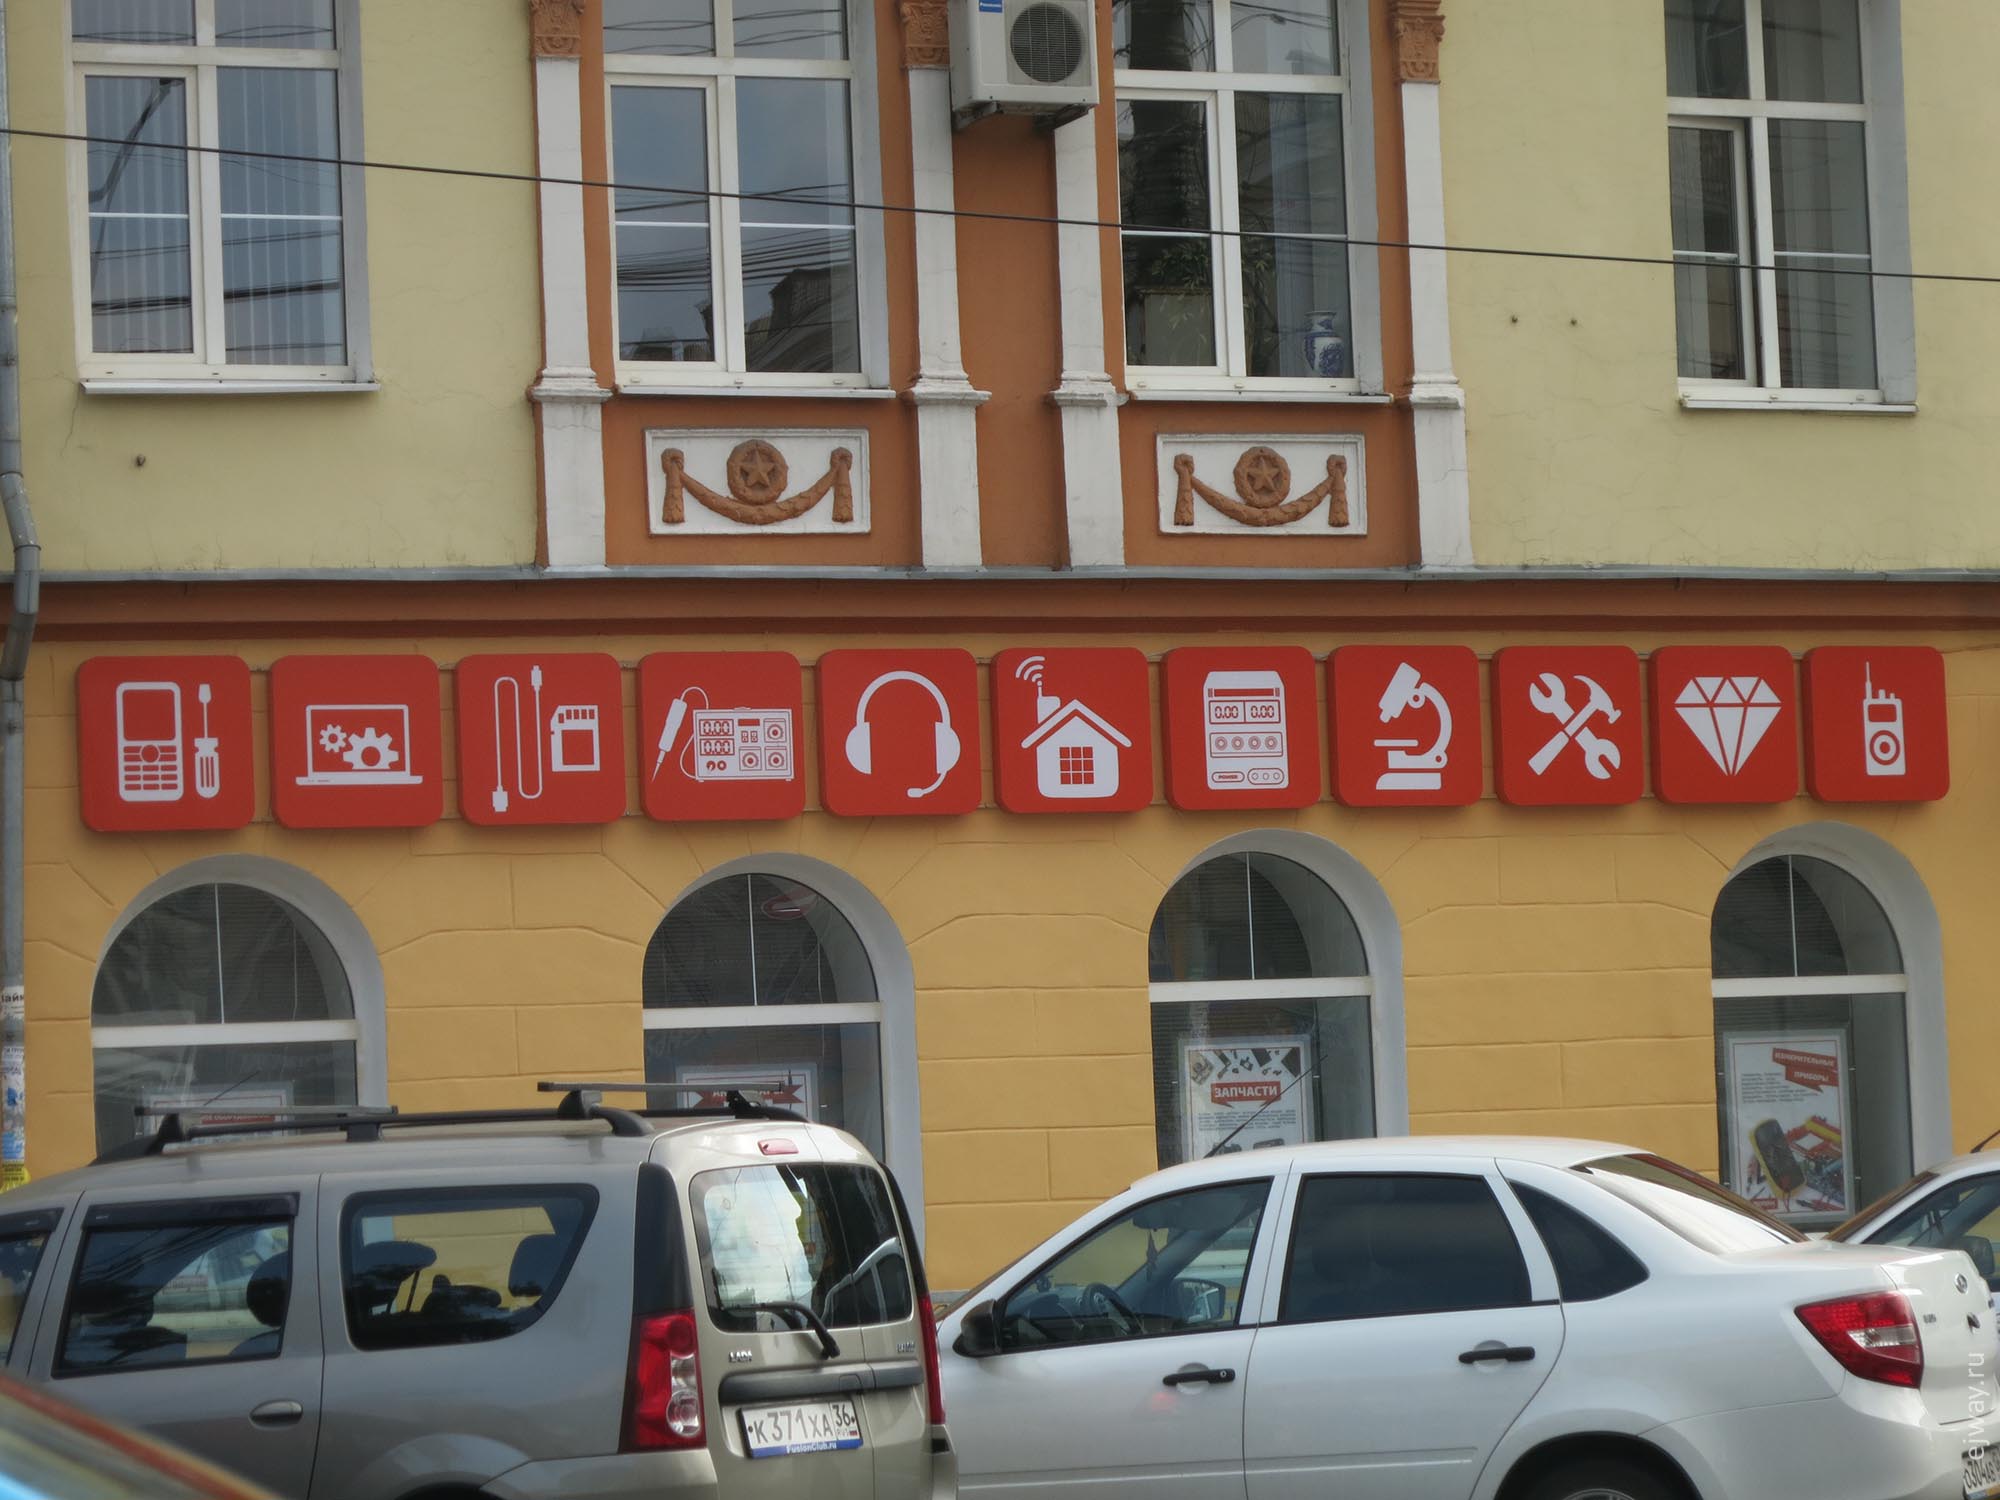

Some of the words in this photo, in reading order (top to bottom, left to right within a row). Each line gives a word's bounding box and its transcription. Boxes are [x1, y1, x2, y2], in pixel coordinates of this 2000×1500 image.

[1214, 705, 1239, 719] 0.00
[1250, 705, 1275, 719] 0.00
[702, 720, 730, 735] 0.00
[703, 739, 731, 755] 0.00
[1214, 1085, 1278, 1098] ЗАПЧАСТИ
